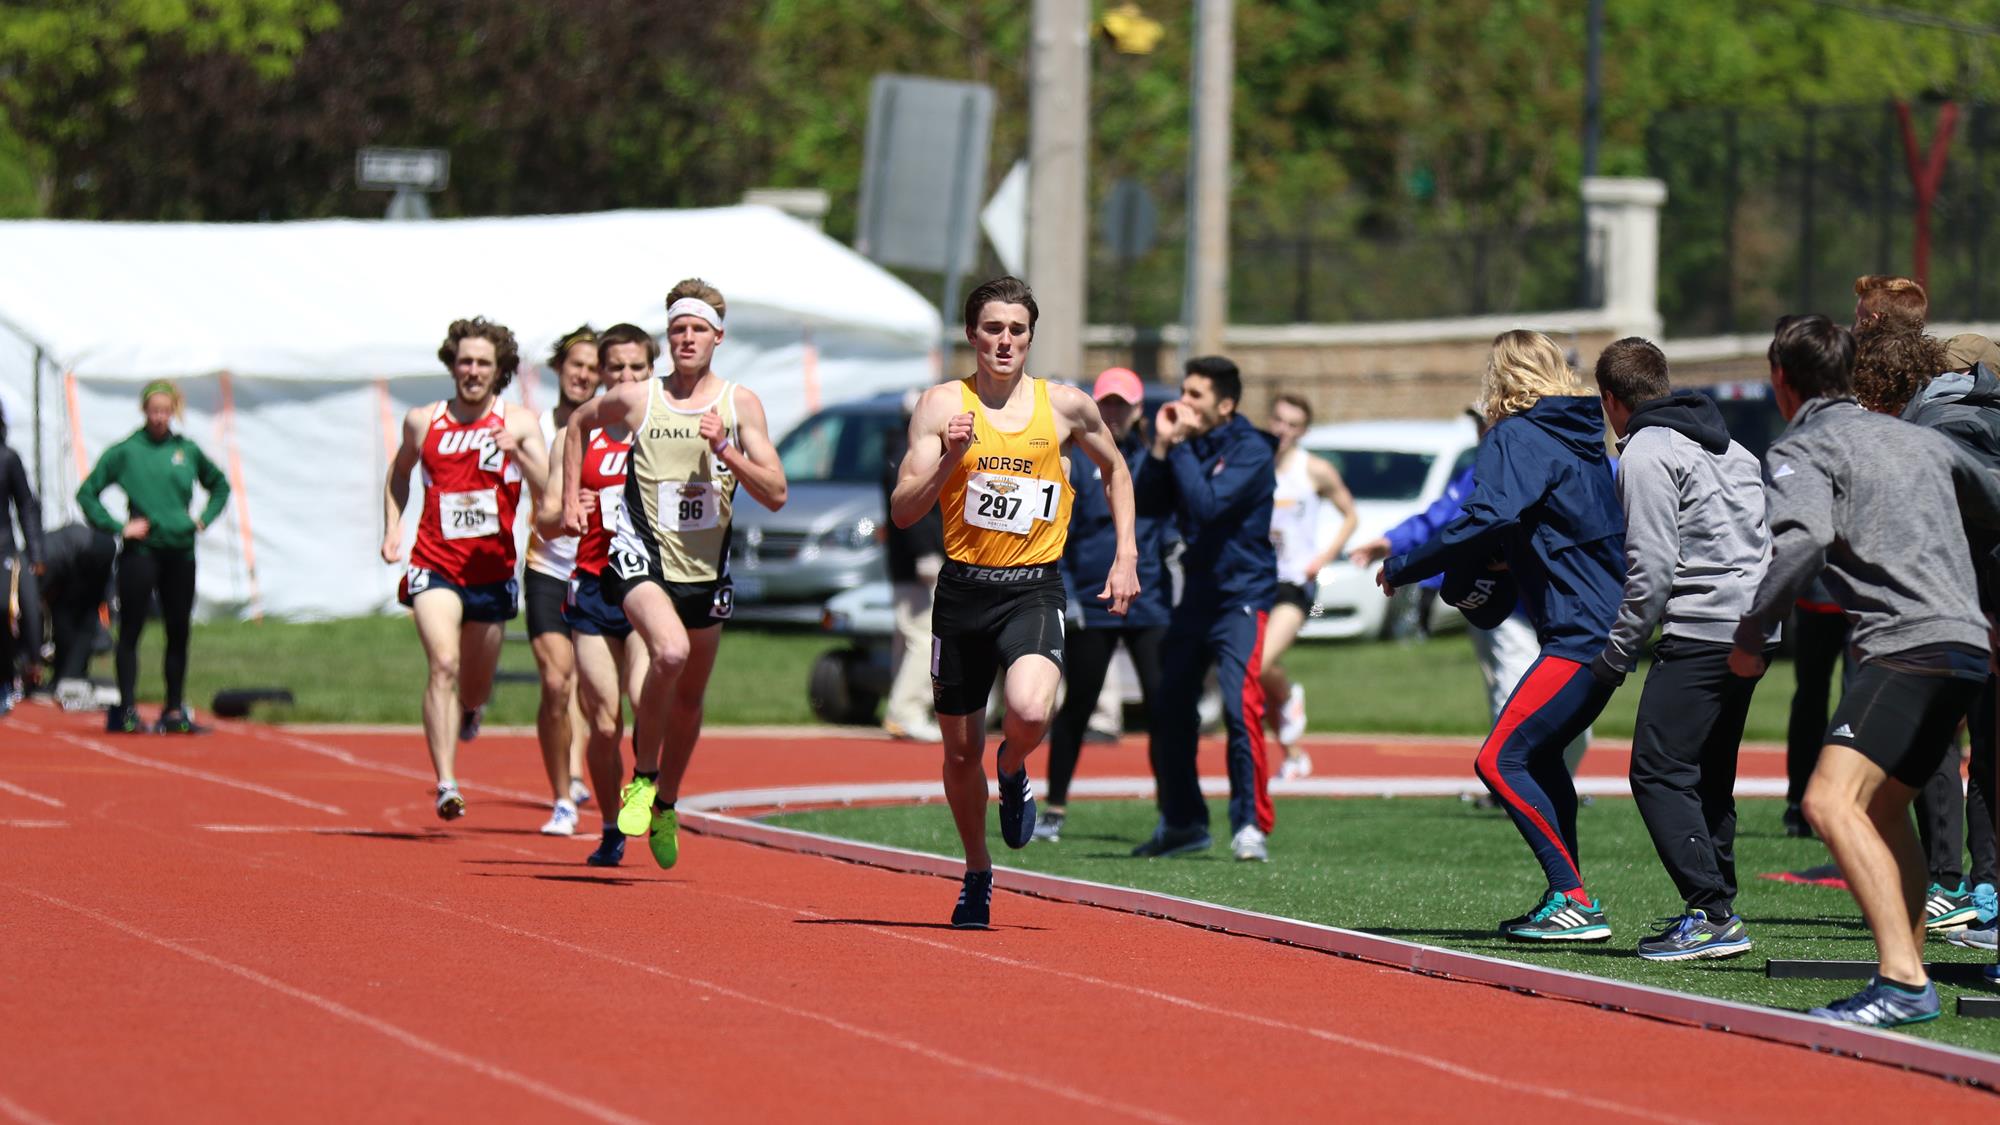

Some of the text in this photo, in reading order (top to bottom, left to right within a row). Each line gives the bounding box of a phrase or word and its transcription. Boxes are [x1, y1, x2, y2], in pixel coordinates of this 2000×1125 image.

[649, 427, 730, 440] OAKL
[483, 437, 498, 467] 2
[977, 456, 1033, 474] NORSE
[678, 500, 703, 521] 96
[977, 493, 1022, 520] 297
[1042, 484, 1055, 518] 1
[624, 551, 645, 573] 9
[716, 588, 732, 616] 9
[1455, 579, 1496, 609] USA
